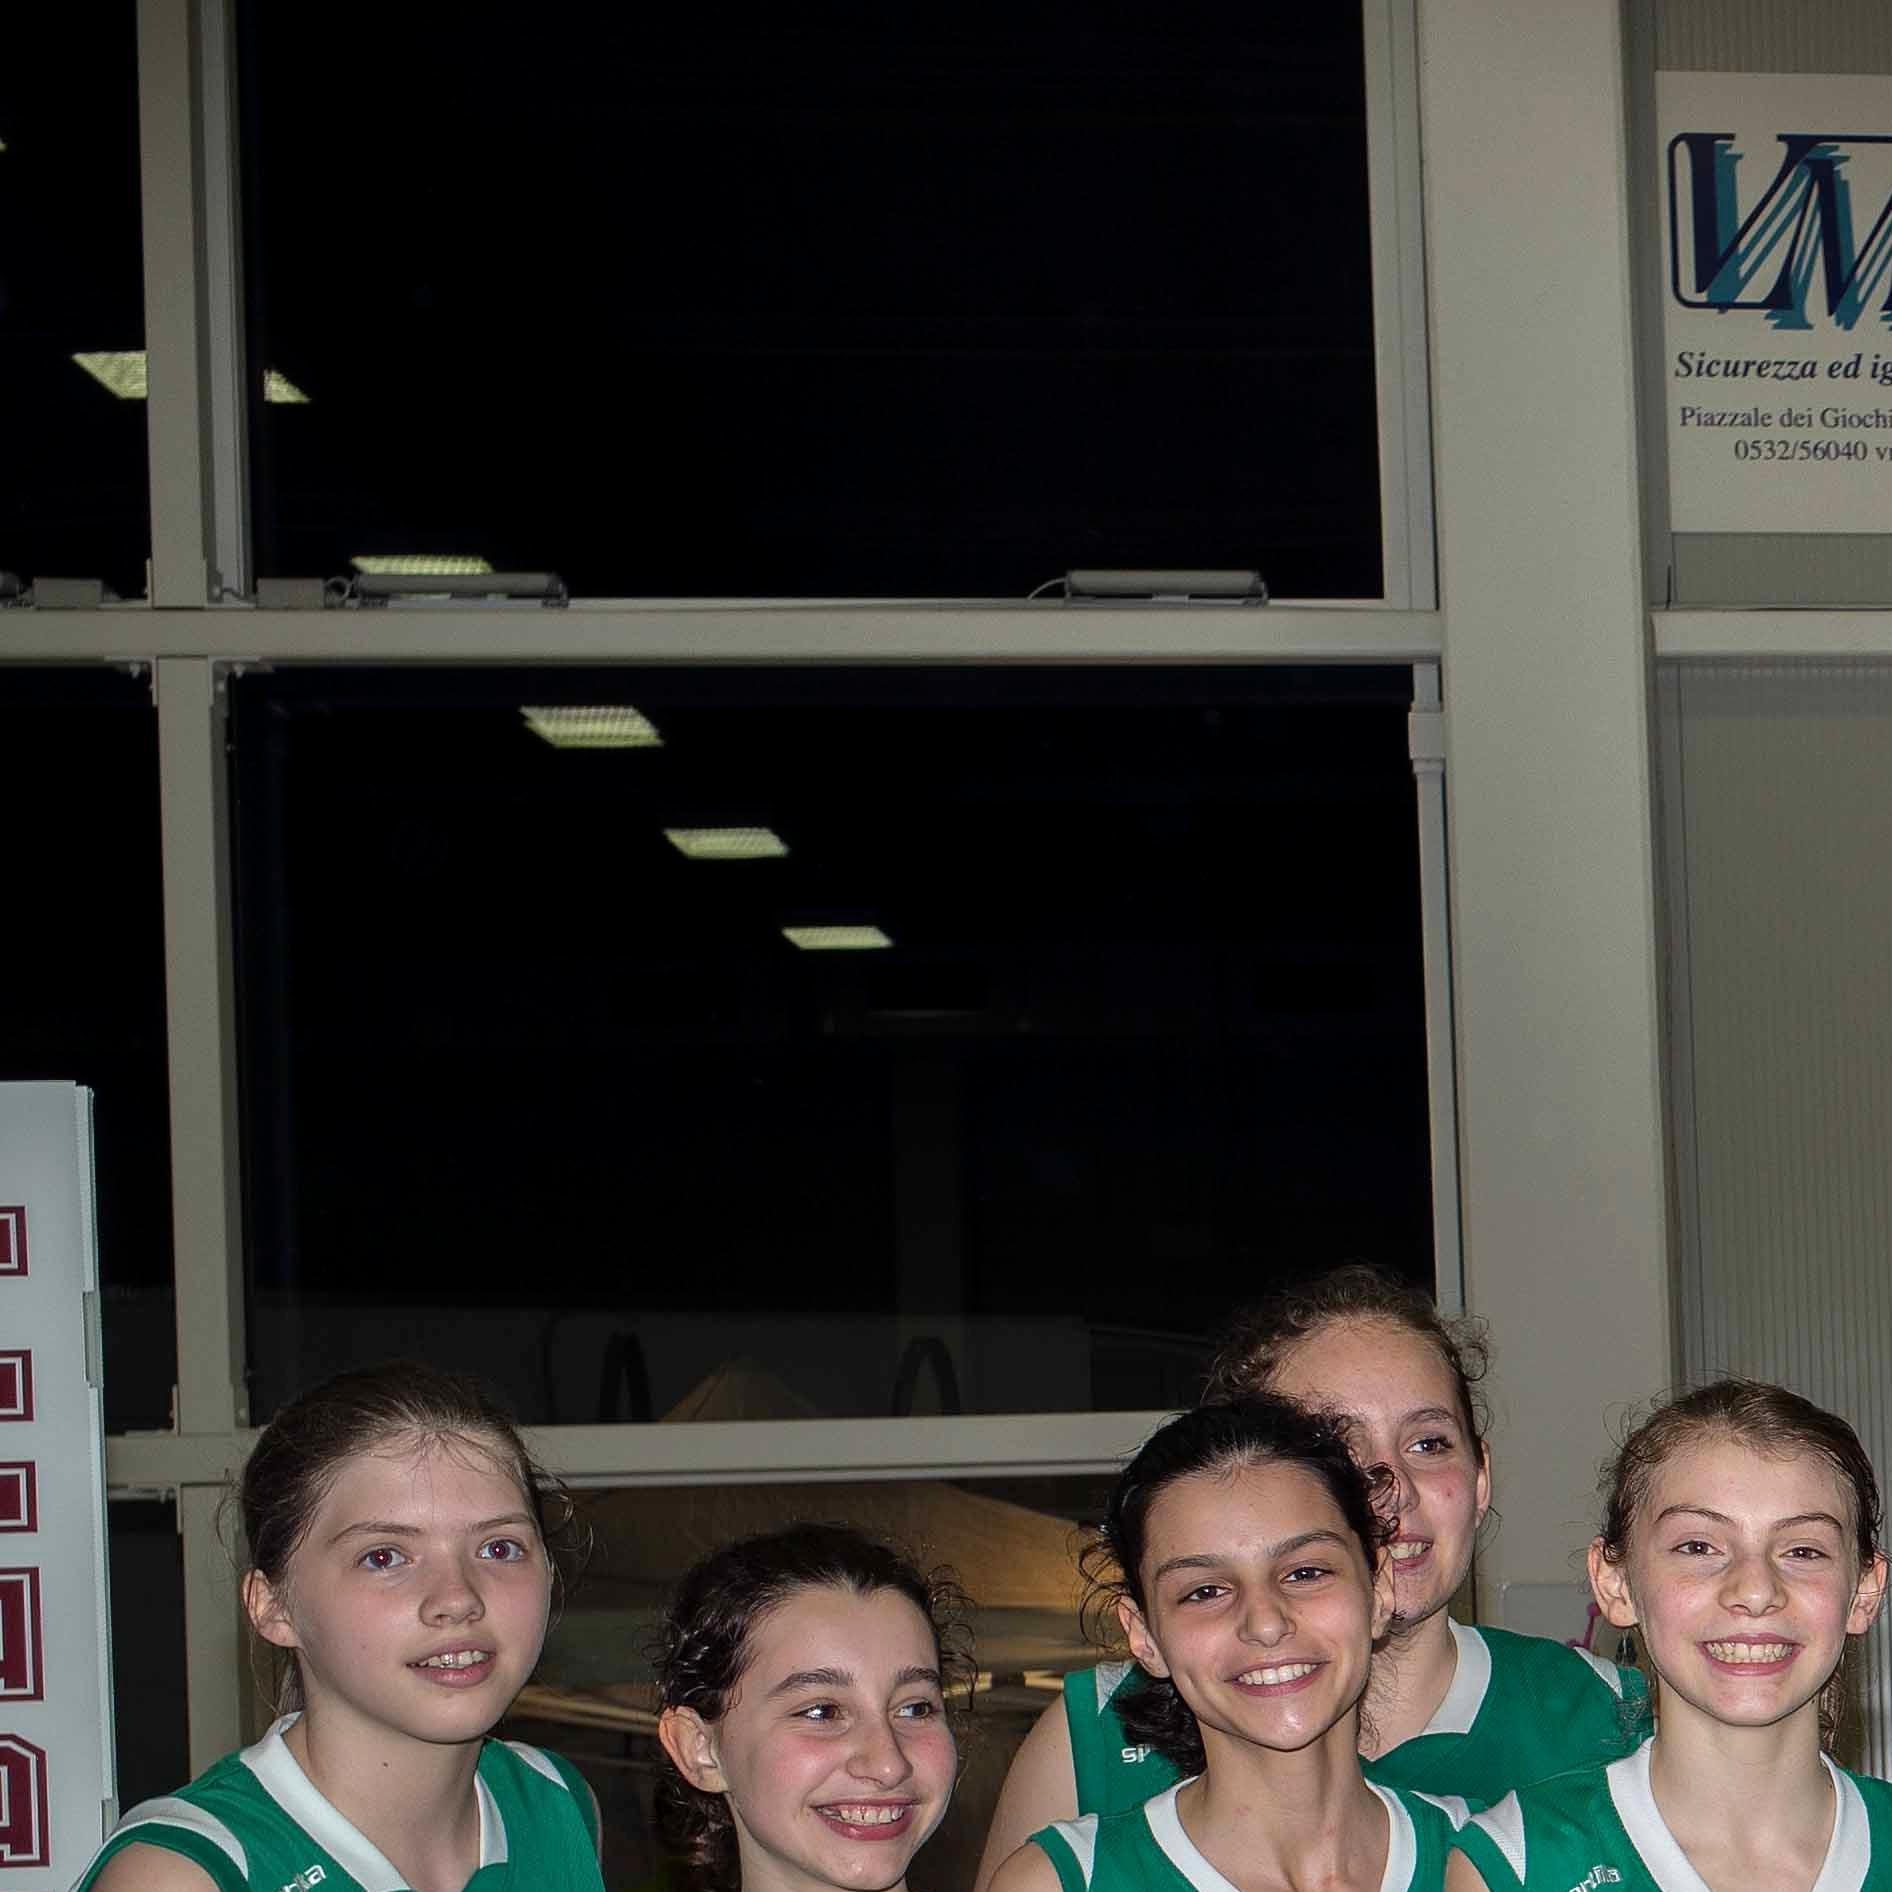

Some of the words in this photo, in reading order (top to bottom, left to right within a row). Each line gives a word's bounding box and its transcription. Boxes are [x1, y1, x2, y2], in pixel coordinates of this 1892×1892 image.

[1674, 352, 1817, 384] Sicurezza
[1827, 355, 1862, 382] ed
[1680, 406, 1772, 432] Piazzale
[1781, 406, 1814, 431] dei
[1734, 441, 1868, 465] 0532/56040
